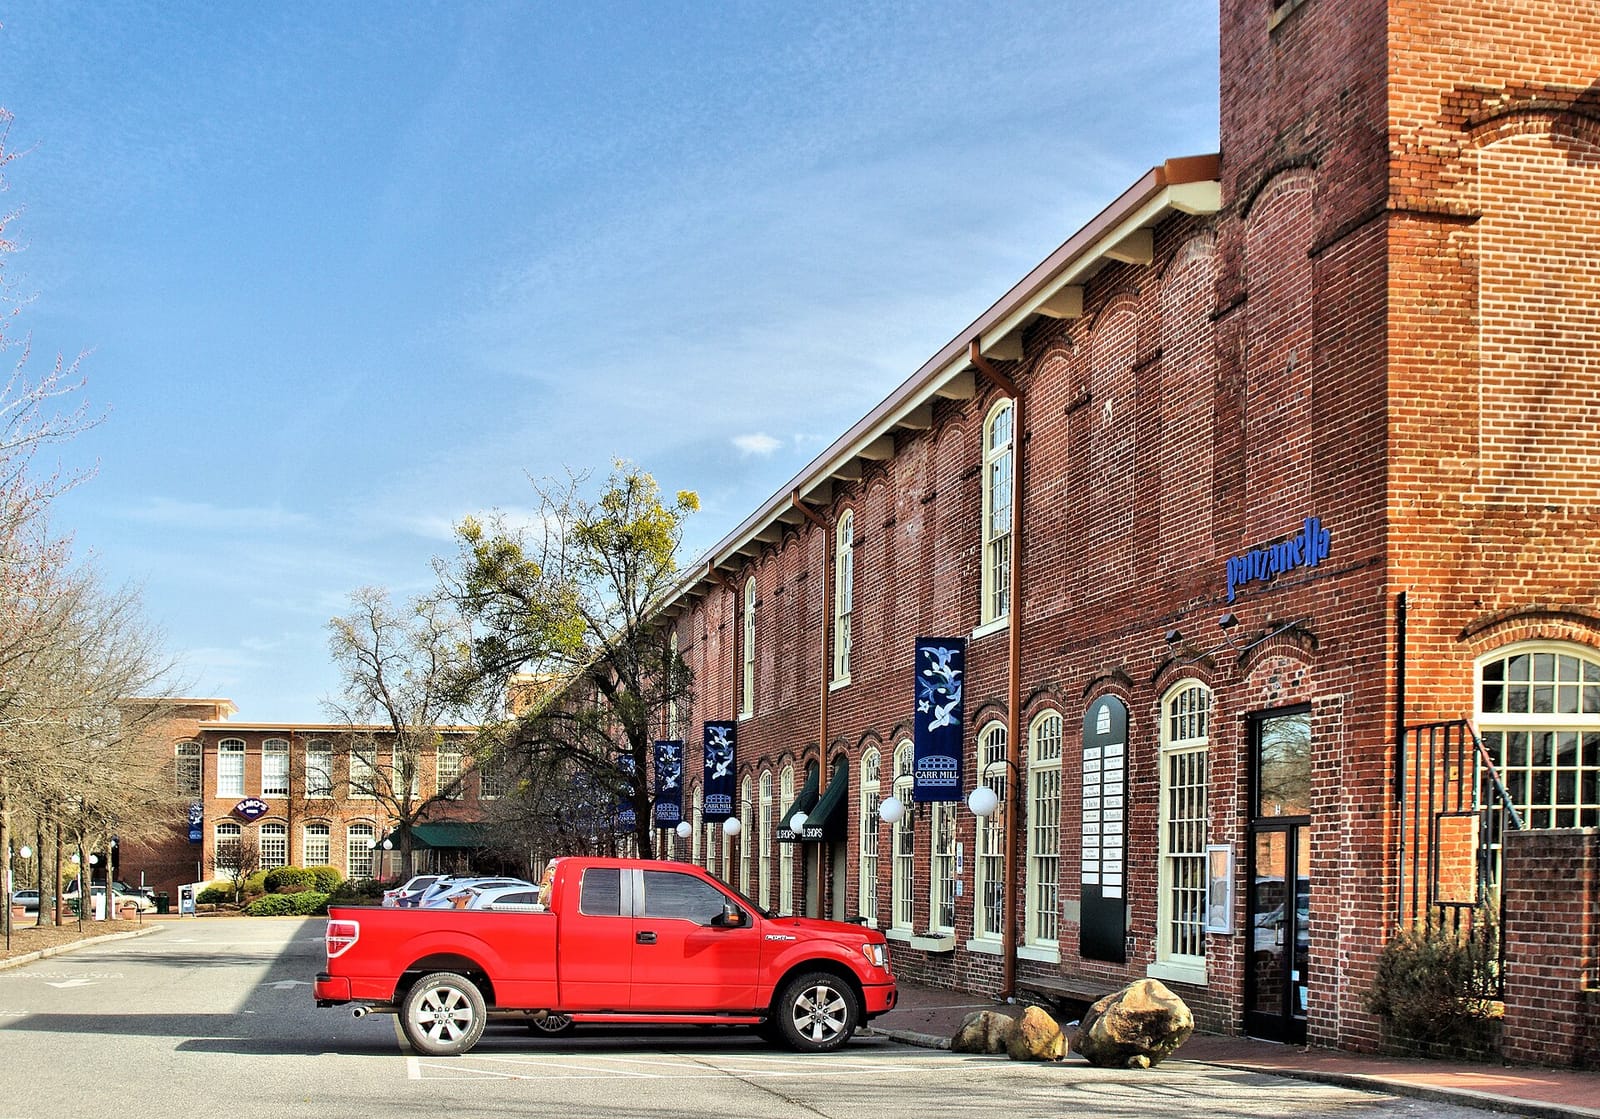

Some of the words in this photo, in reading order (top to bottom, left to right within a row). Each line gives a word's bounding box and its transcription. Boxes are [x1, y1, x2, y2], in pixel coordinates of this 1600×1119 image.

[915, 771, 938, 779] CARR
[940, 771, 960, 779] MILL
[780, 829, 796, 839] SHOPS
[806, 827, 822, 838] SHOPS
